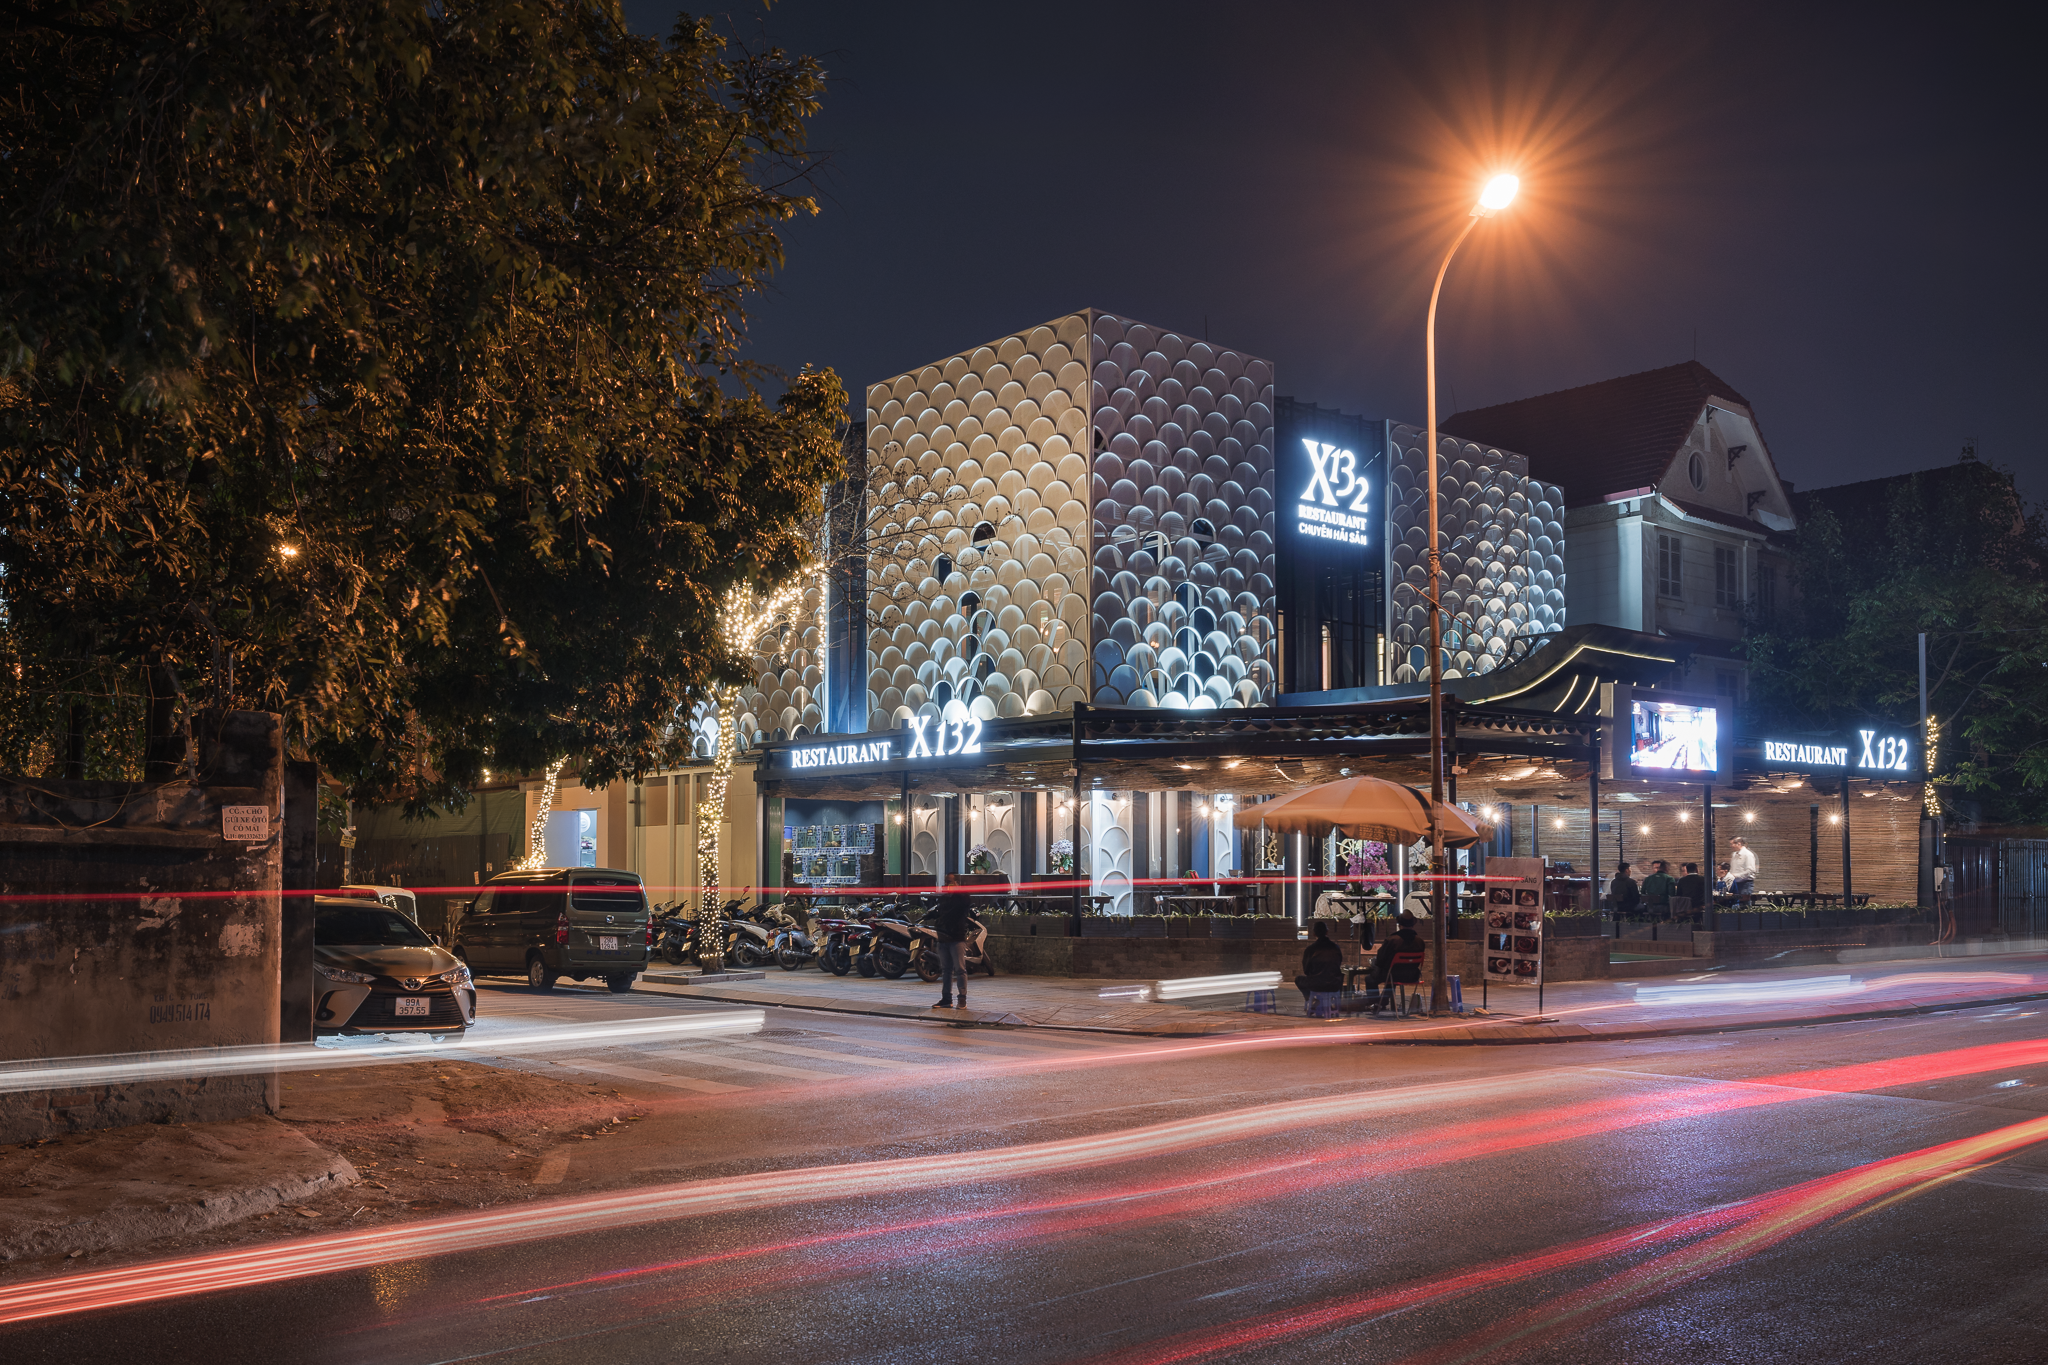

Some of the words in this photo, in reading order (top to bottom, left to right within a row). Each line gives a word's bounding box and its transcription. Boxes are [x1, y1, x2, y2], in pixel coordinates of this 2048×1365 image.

[1300, 438, 1369, 513] X132
[1298, 504, 1367, 531] RESTAURANT
[1298, 522, 1333, 539] CHUYÊN
[791, 741, 891, 768] RESTAURANT
[907, 715, 982, 758] X132
[1764, 741, 1848, 766] RESTAURANT
[1858, 729, 1908, 770] X132
[399, 1006, 426, 1015] 357.55
[405, 998, 420, 1006] 89A
